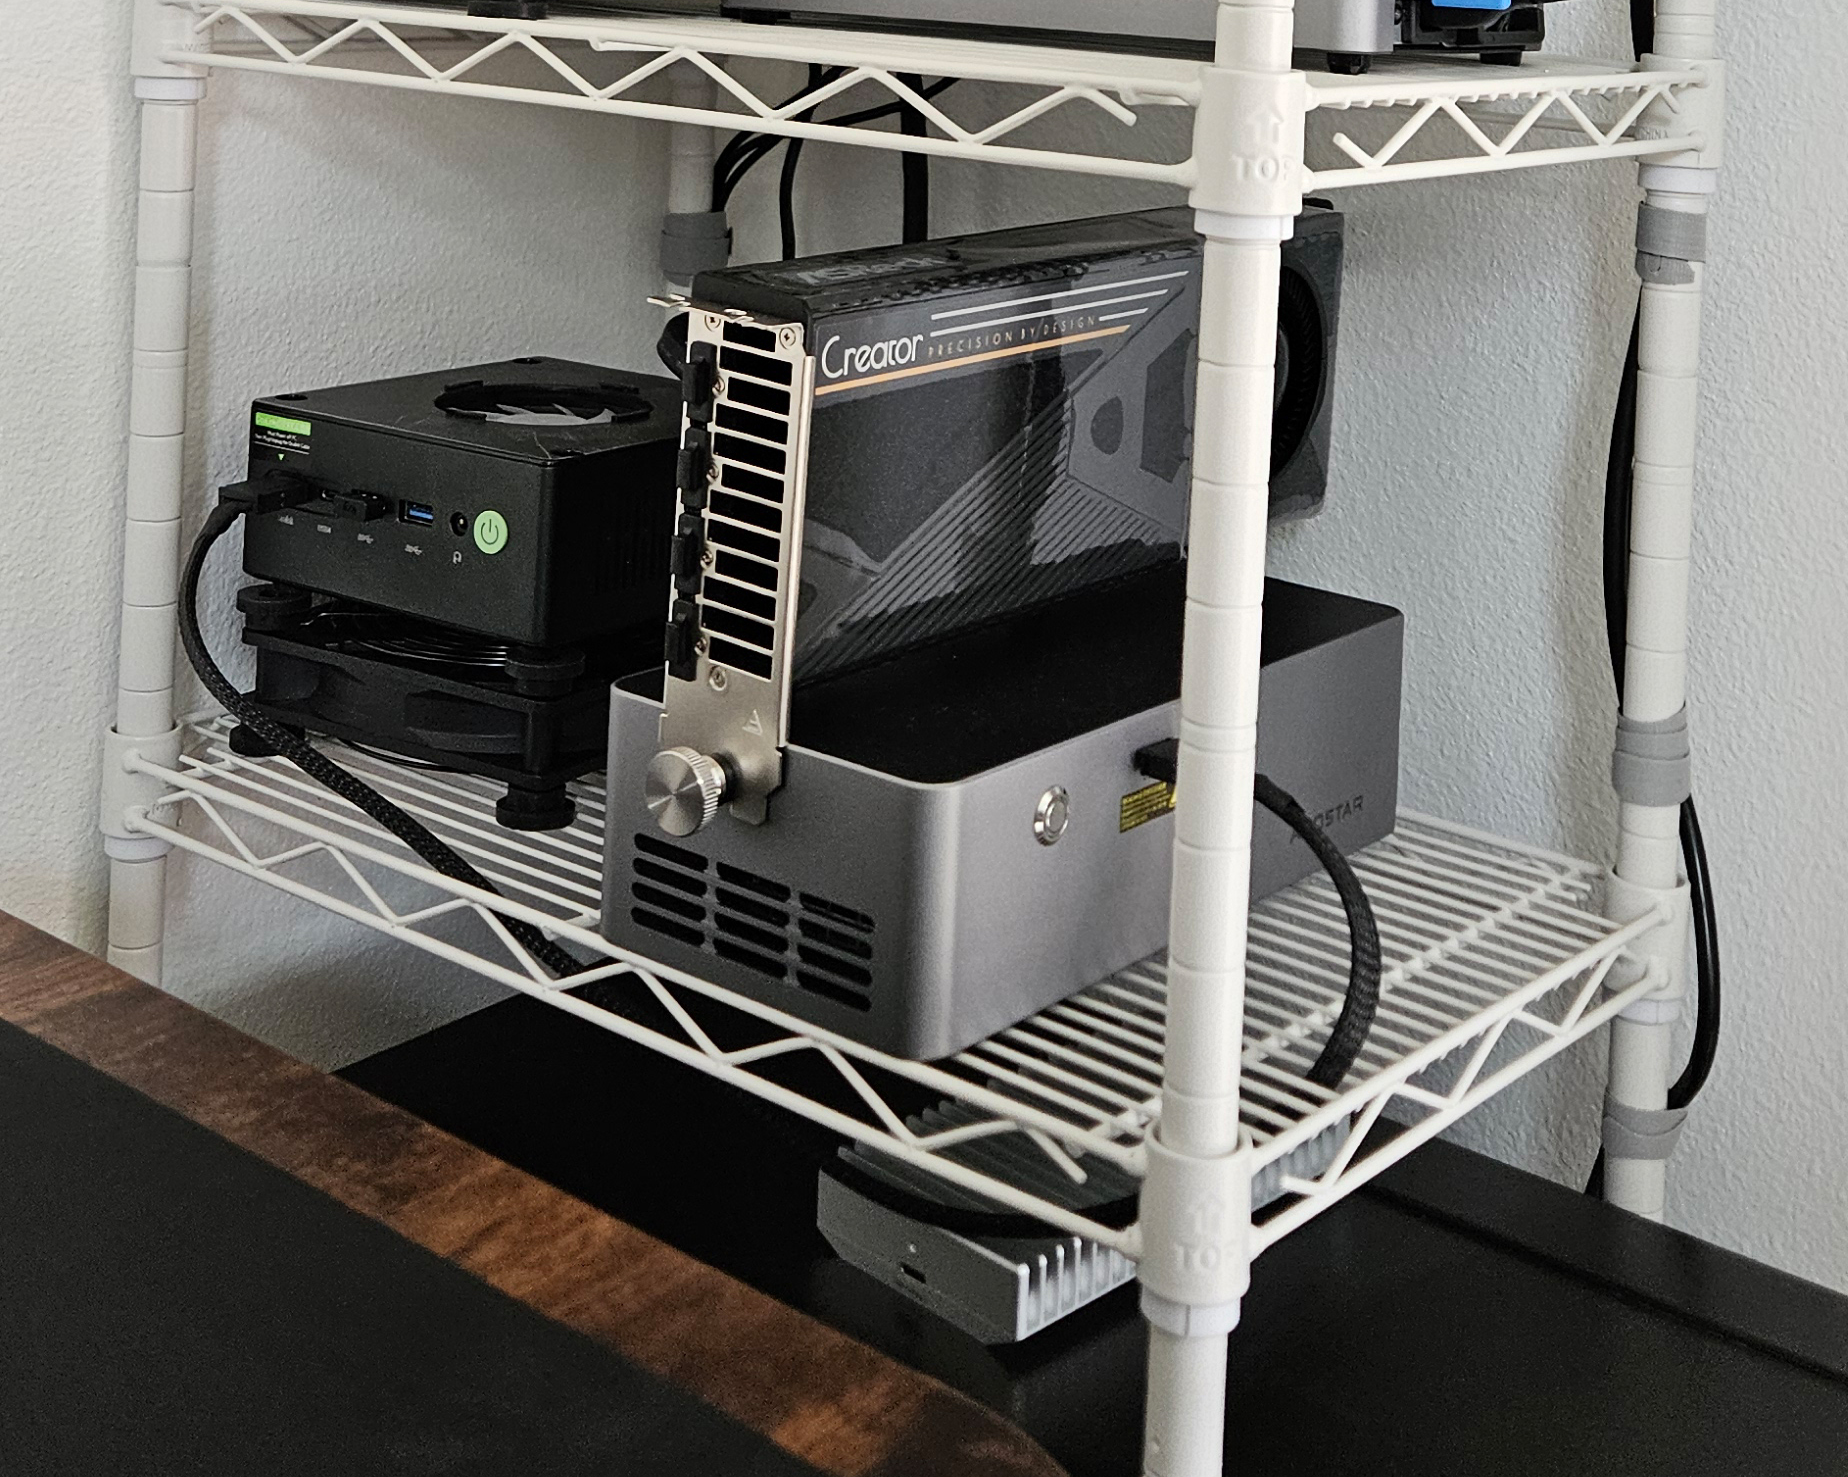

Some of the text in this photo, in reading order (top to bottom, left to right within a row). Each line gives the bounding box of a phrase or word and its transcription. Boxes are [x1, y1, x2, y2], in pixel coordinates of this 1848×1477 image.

[821, 333, 924, 379] Creator
[927, 315, 1096, 359] PRECISION BY DESIGN
[1289, 794, 1364, 845] OSTAR
